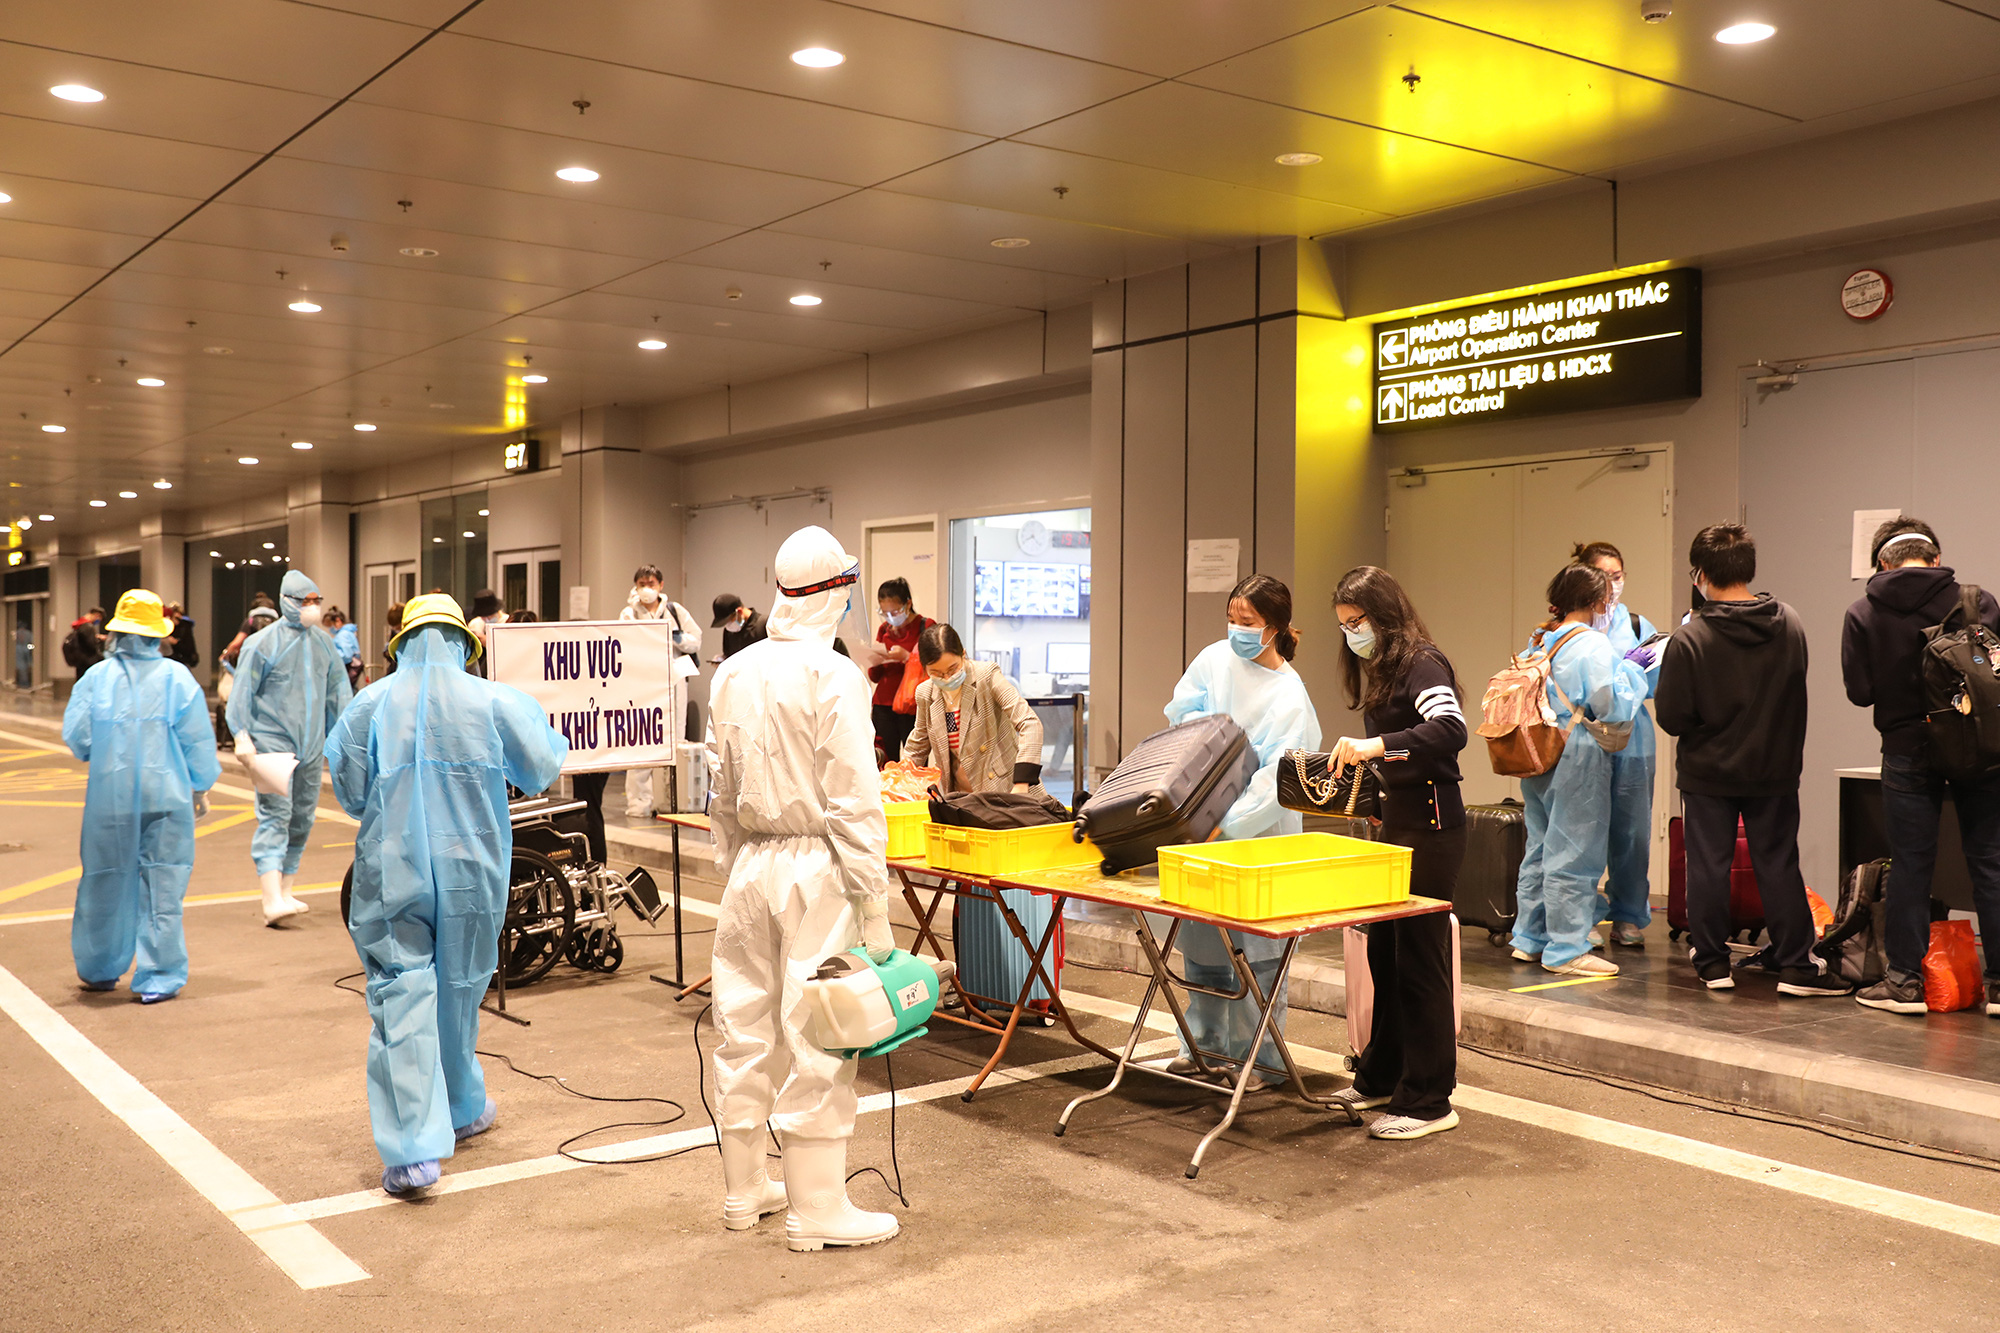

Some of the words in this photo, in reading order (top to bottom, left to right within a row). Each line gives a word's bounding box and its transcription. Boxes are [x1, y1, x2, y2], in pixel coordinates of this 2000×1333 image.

[1409, 319, 1467, 346] PHÒNG
[1512, 301, 1564, 328] HÀNH
[1566, 291, 1612, 319] KHAI
[1614, 280, 1670, 310] THÁC
[1409, 341, 1459, 367] Airport
[1460, 330, 1539, 360] Operation
[1541, 320, 1600, 345] Center
[1408, 374, 1467, 401] PHÒNG
[1468, 367, 1497, 392] TÀI
[1499, 361, 1539, 390] LIỆU
[1541, 361, 1557, 382] &
[1559, 352, 1613, 380] HDCX
[1409, 397, 1446, 420] Load
[1448, 389, 1505, 415] Control
[543, 641, 581, 681] KHU
[586, 635, 623, 688] VỰC
[561, 696, 600, 751] KHỬ
[603, 700, 664, 749] TRÙNG
